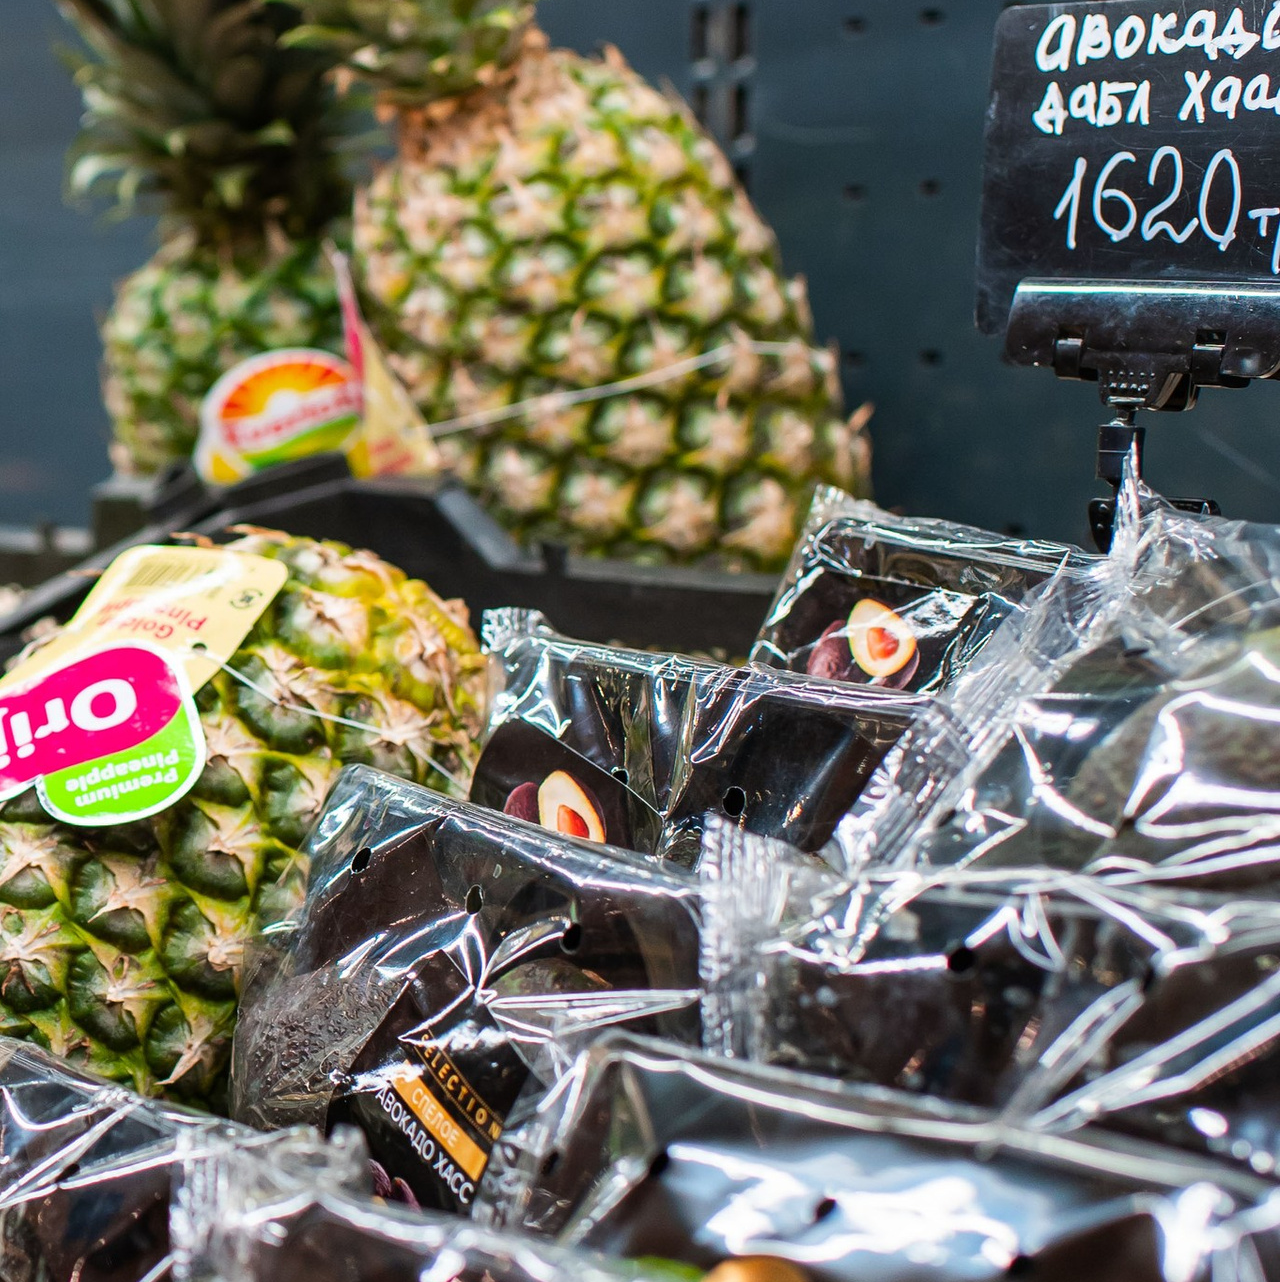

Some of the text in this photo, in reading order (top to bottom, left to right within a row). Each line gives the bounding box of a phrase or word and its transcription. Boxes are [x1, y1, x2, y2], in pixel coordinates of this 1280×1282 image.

[65, 748, 180, 792] Pineapple
[74, 766, 179, 807] Premium
[410, 1087, 461, 1148] СПЕЛОЕ
[419, 1033, 503, 1142] SELECTION
[375, 1085, 475, 1204] АВОКАДО ХАСС
